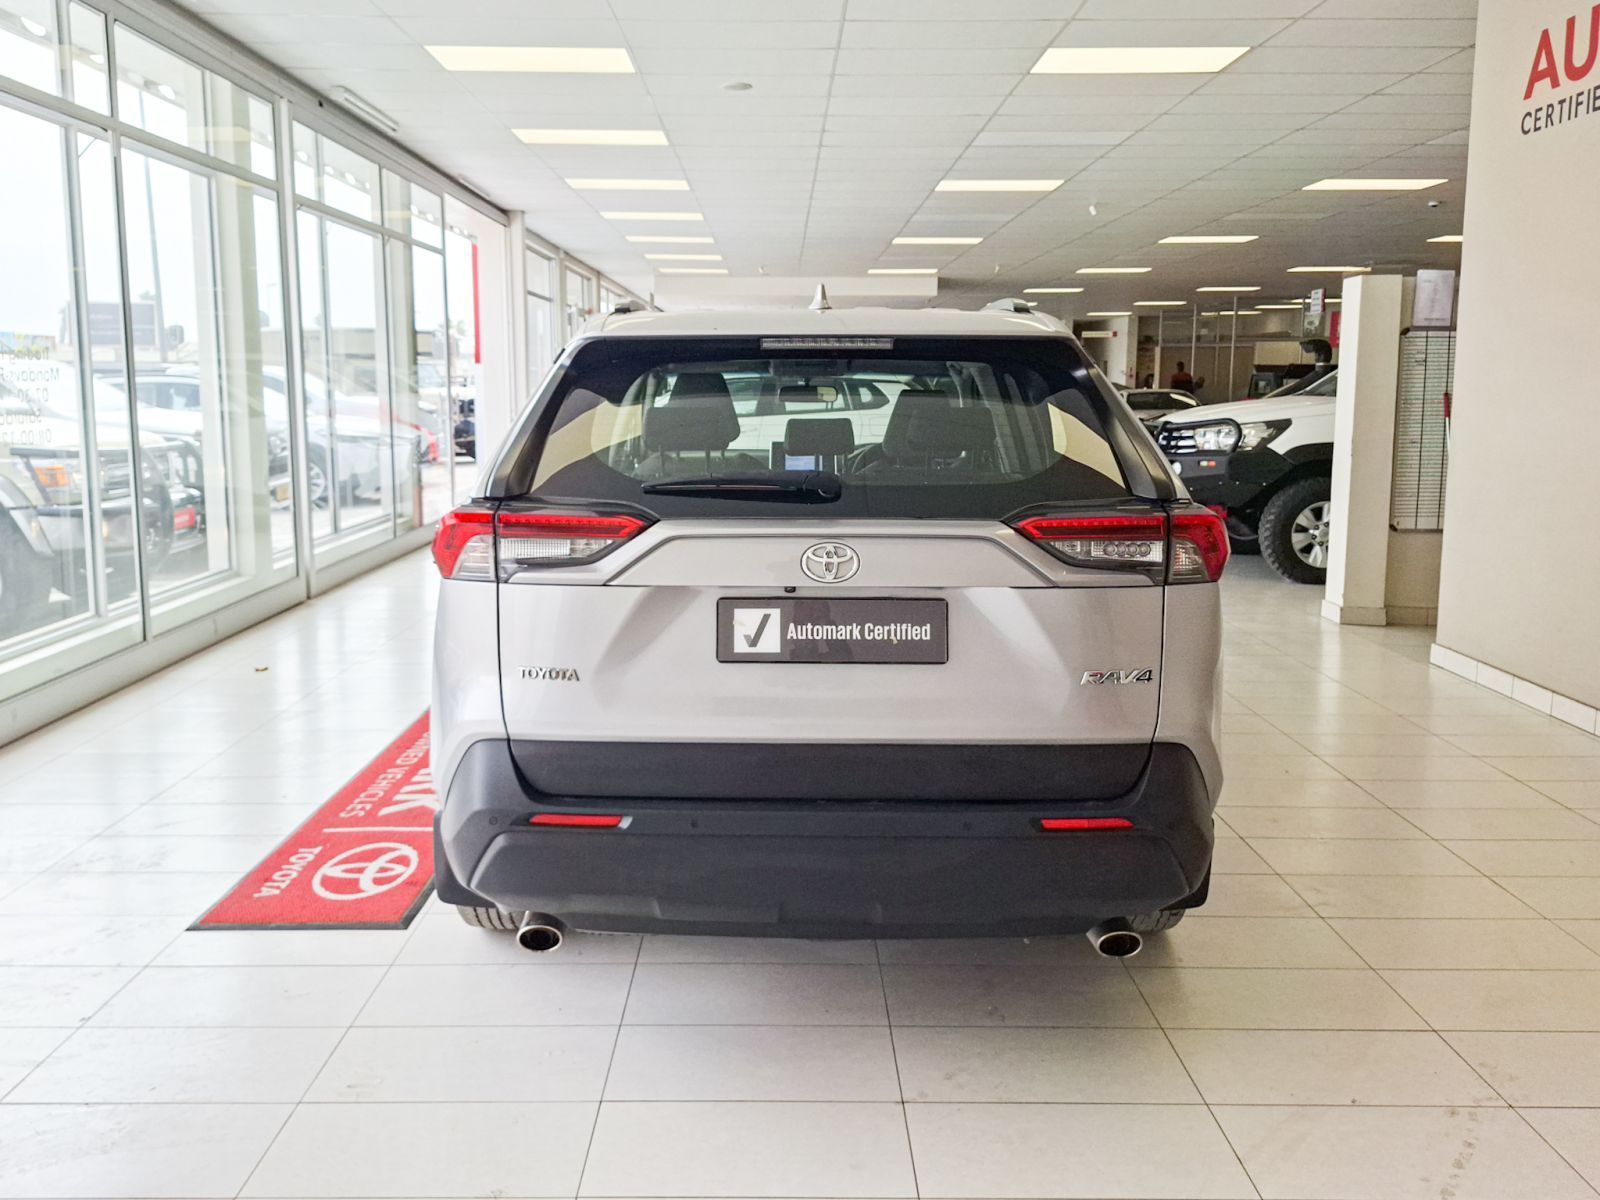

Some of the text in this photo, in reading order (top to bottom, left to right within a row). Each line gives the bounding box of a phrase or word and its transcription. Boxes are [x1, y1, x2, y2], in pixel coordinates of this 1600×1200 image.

[1523, 3, 1600, 101] AU
[787, 623, 931, 642] Automark Certified
[519, 666, 580, 681] TOYOTA
[1080, 668, 1152, 685] RAV4
[339, 766, 410, 817] VEHICLES
[253, 846, 323, 897] TOYOTA
